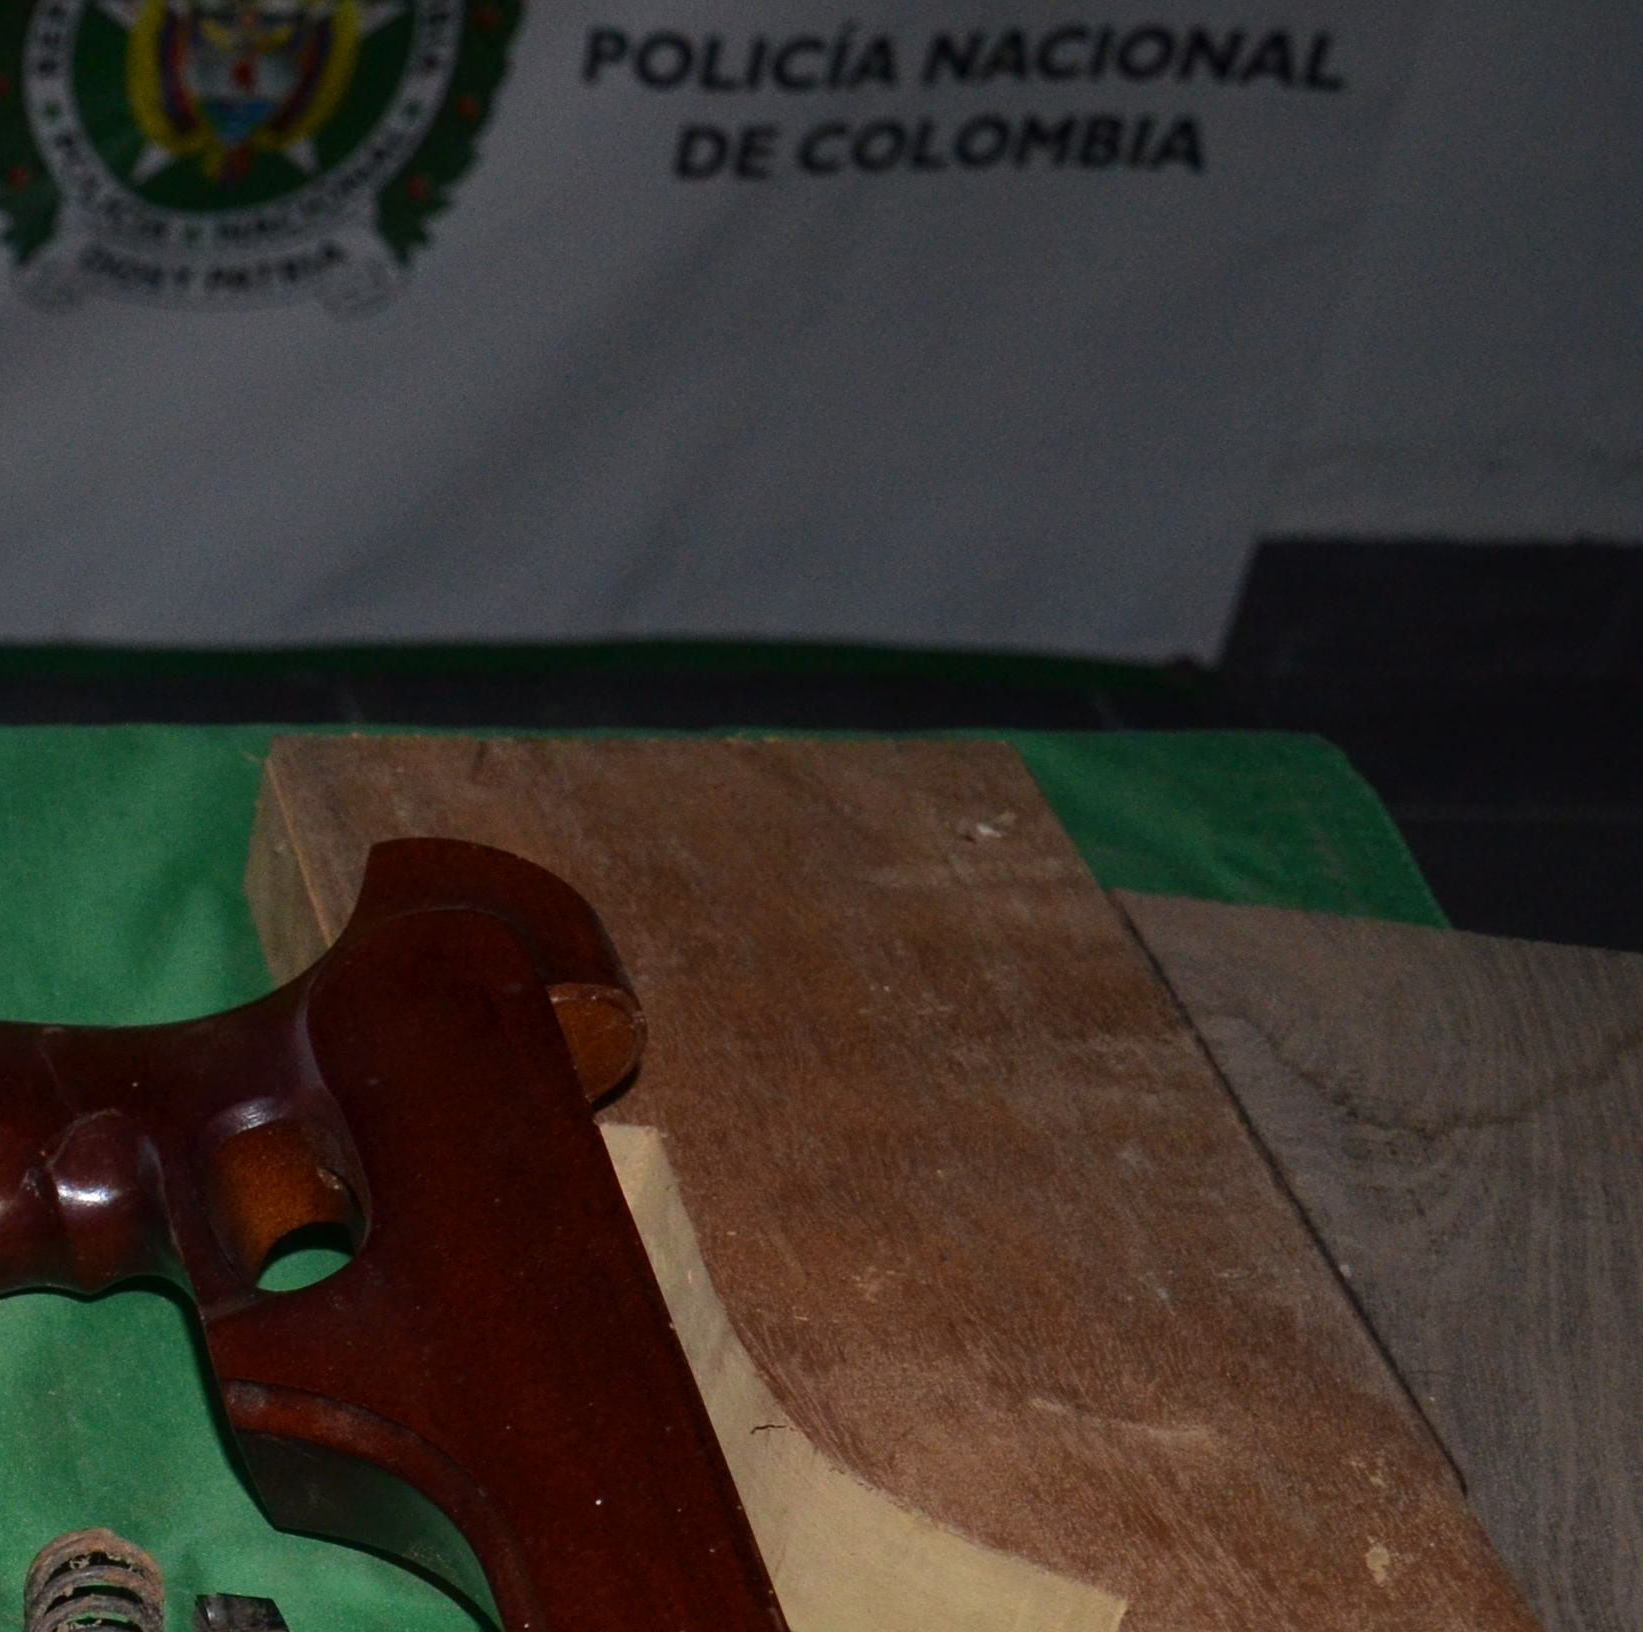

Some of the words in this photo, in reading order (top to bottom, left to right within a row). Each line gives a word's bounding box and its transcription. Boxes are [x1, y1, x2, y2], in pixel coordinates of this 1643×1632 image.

[581, 23, 898, 91] POLICÍA
[921, 25, 1346, 91] NACIONAL
[673, 122, 778, 180] DE
[798, 112, 1206, 174] COLOMBIA
